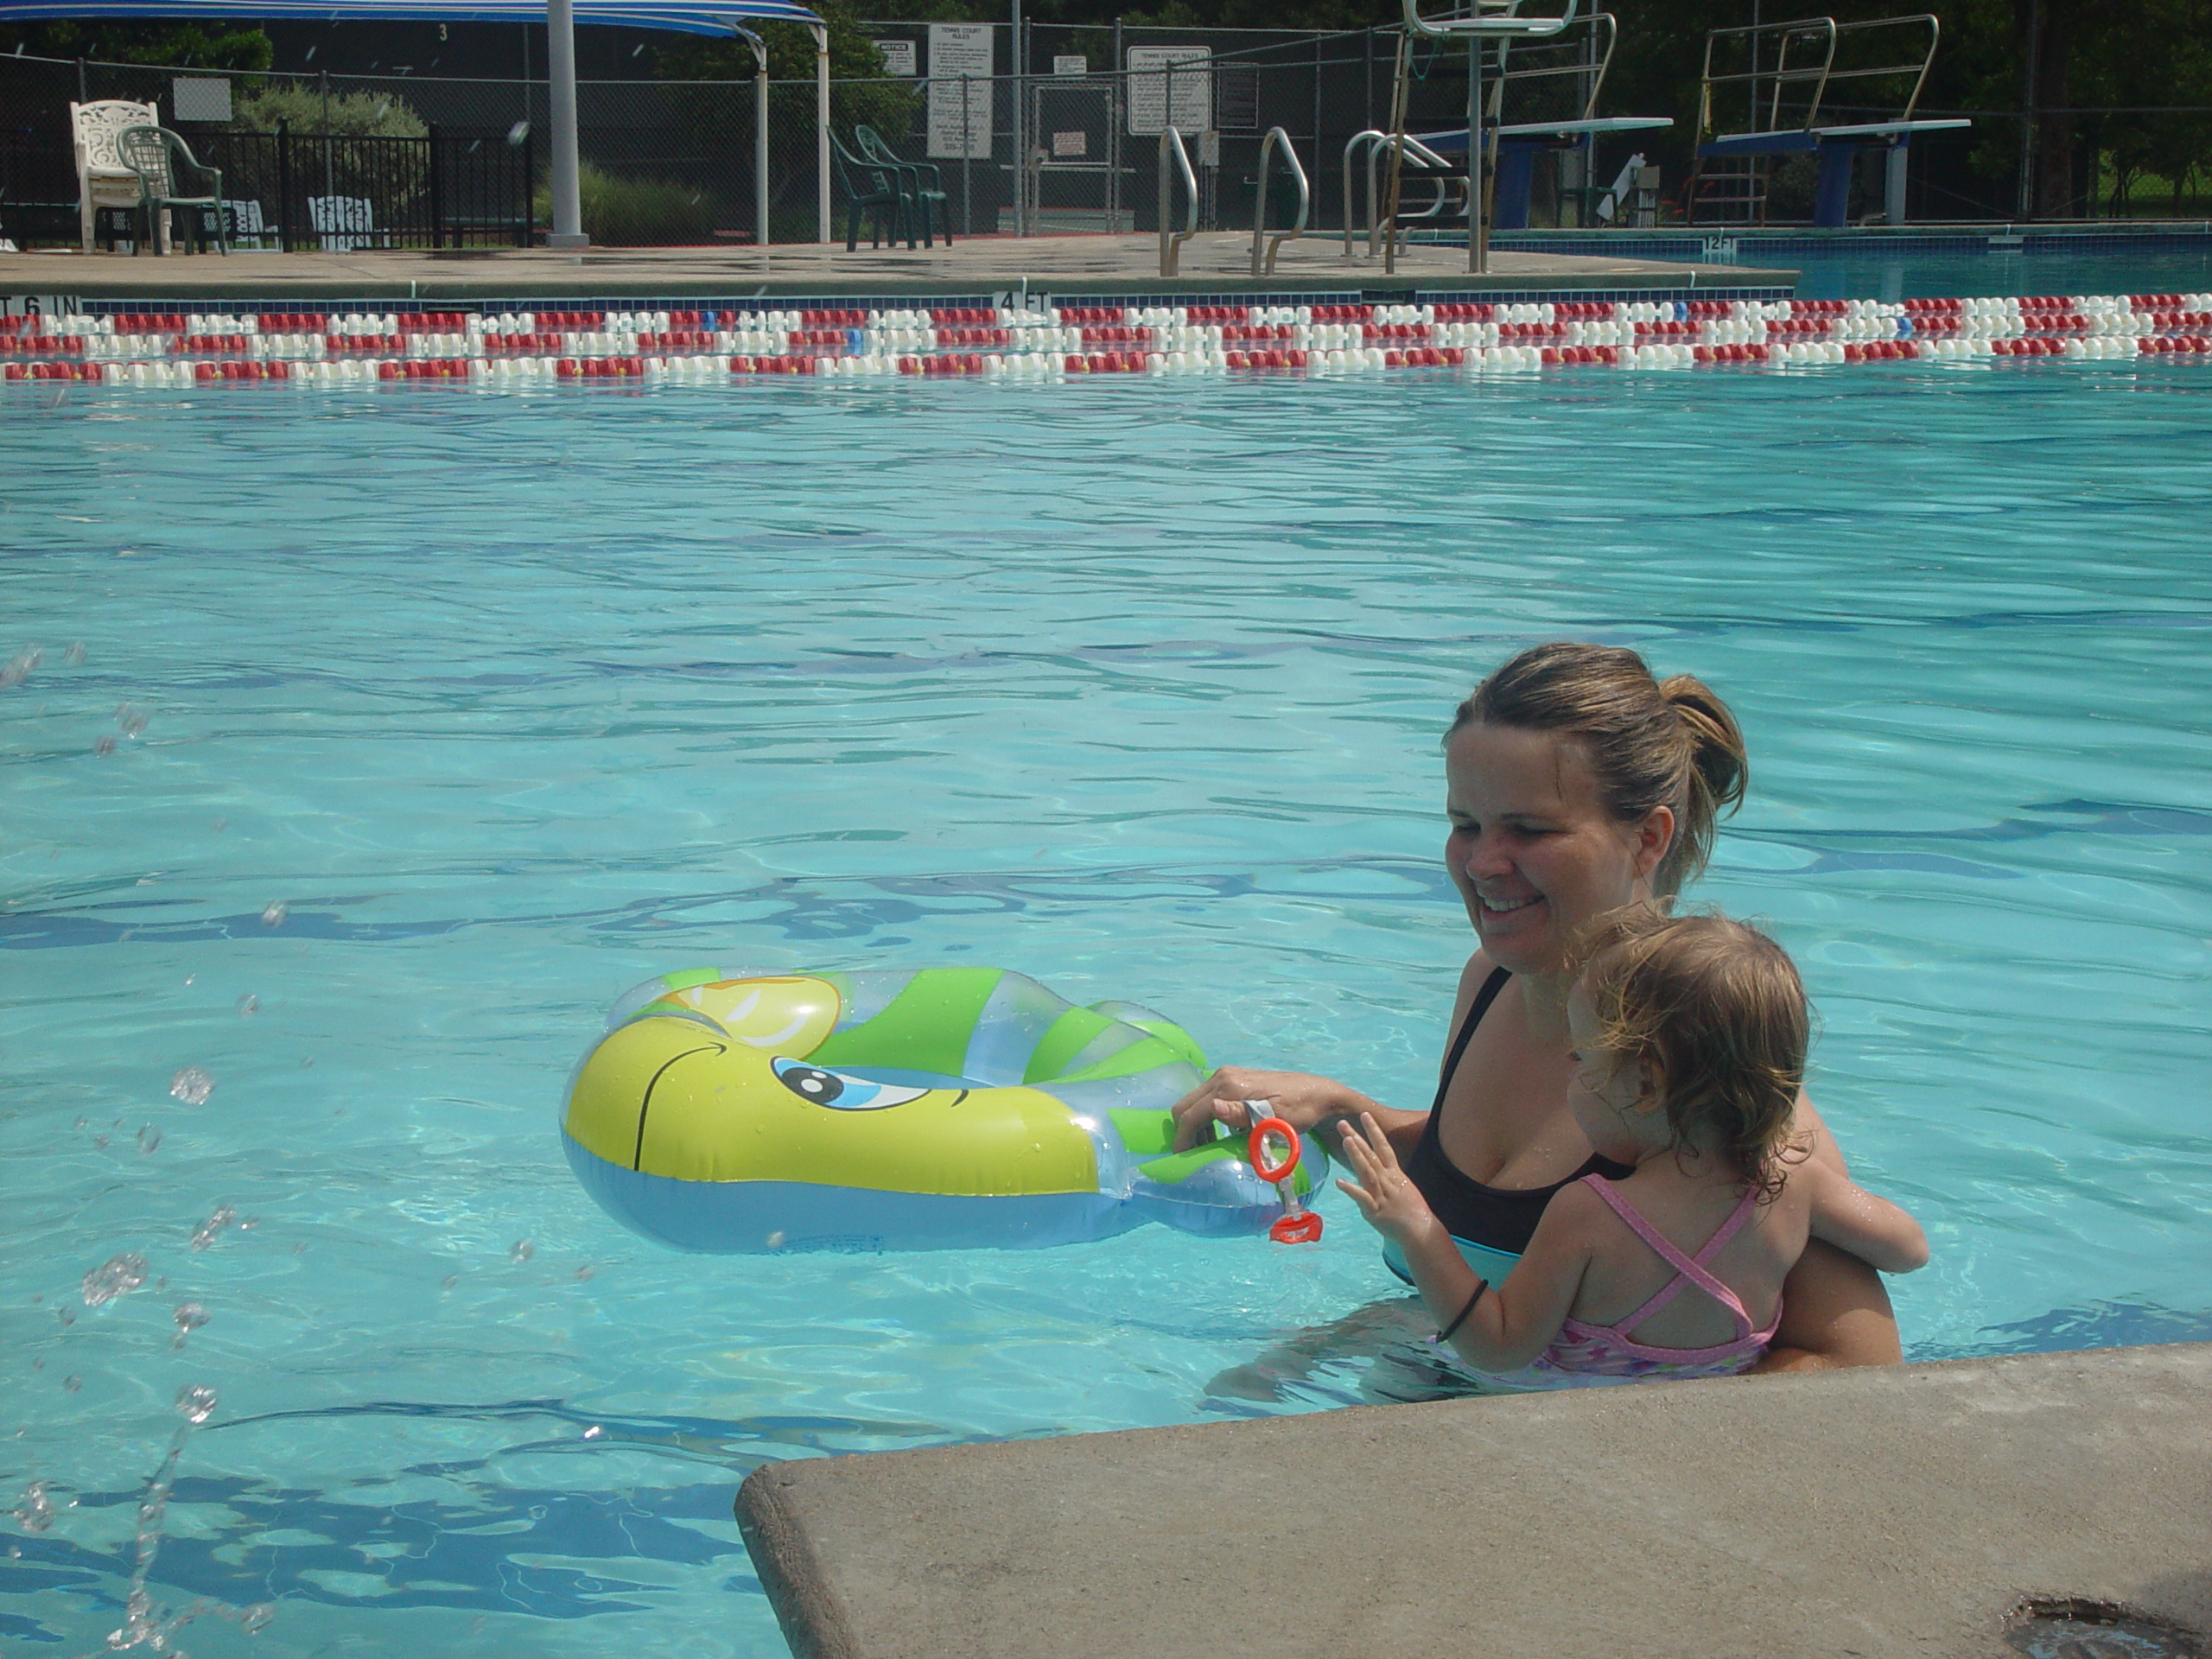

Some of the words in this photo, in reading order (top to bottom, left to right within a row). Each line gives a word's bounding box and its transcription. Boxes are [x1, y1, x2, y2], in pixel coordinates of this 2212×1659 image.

[439, 23, 448, 41] 3
[24, 296, 41, 316] 6
[53, 296, 78, 318] IN
[1001, 291, 1015, 315] 4
[1025, 291, 1049, 313] FT
